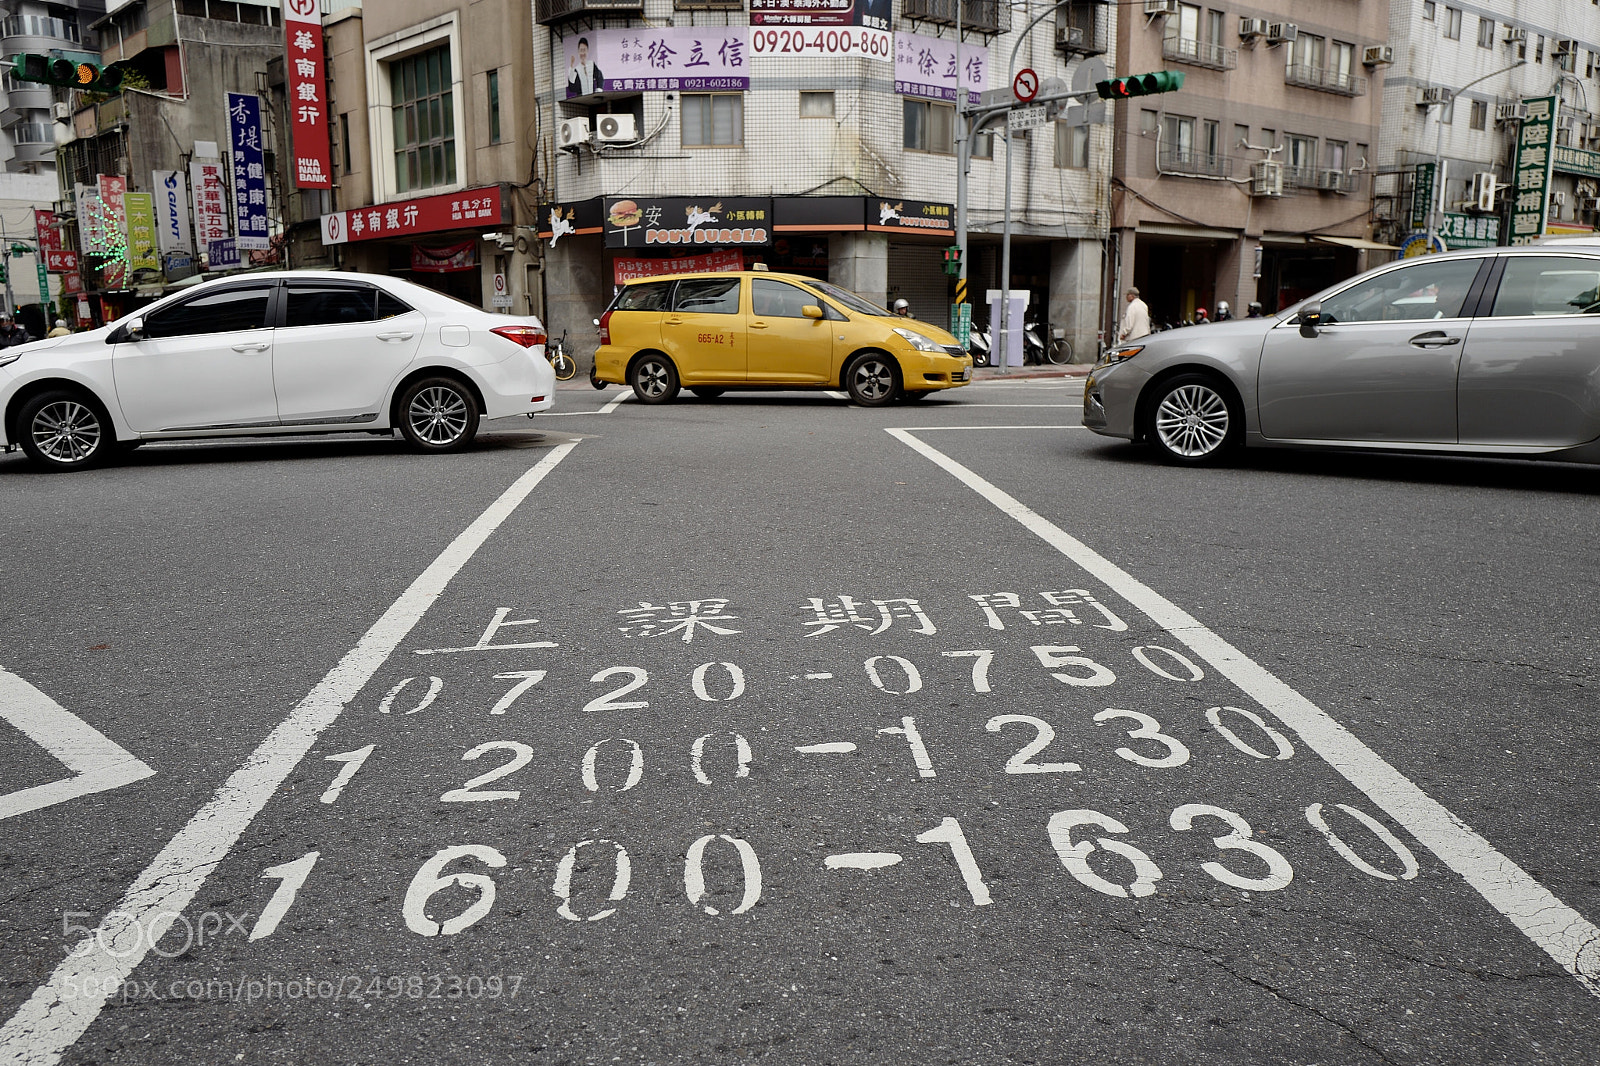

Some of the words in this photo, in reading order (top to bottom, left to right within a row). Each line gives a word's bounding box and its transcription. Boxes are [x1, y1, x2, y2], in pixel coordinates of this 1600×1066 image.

[620, 37, 643, 49] 台大
[647, 38, 745, 69] 徐立信
[753, 30, 889, 57] 0920-400-860
[620, 53, 643, 65] 律師
[917, 48, 983, 84] 徐立信
[293, 30, 320, 125] 華南銀行
[612, 78, 680, 90] 免費法律諮詢
[684, 78, 743, 88] 0921-602186
[298, 157, 320, 167] HUA
[298, 166, 321, 175] NAN
[299, 174, 327, 183] BANK
[247, 162, 267, 232] 健康館
[167, 191, 180, 240] GIANT
[351, 205, 419, 237] 華南銀行
[451, 212, 462, 221] HUA
[464, 210, 476, 219] NAN
[478, 208, 492, 218] BANK
[919, 217, 950, 229] BURGER
[645, 228, 694, 244] PONY
[694, 228, 768, 244] BURGER
[49, 254, 76, 267] 便當
[697, 333, 724, 344] 665-A2
[414, 588, 1128, 655] 上課期間
[379, 645, 1204, 715] 0720-0750
[320, 706, 1294, 804] 1200-1230
[249, 803, 1418, 942] 1600-1630
